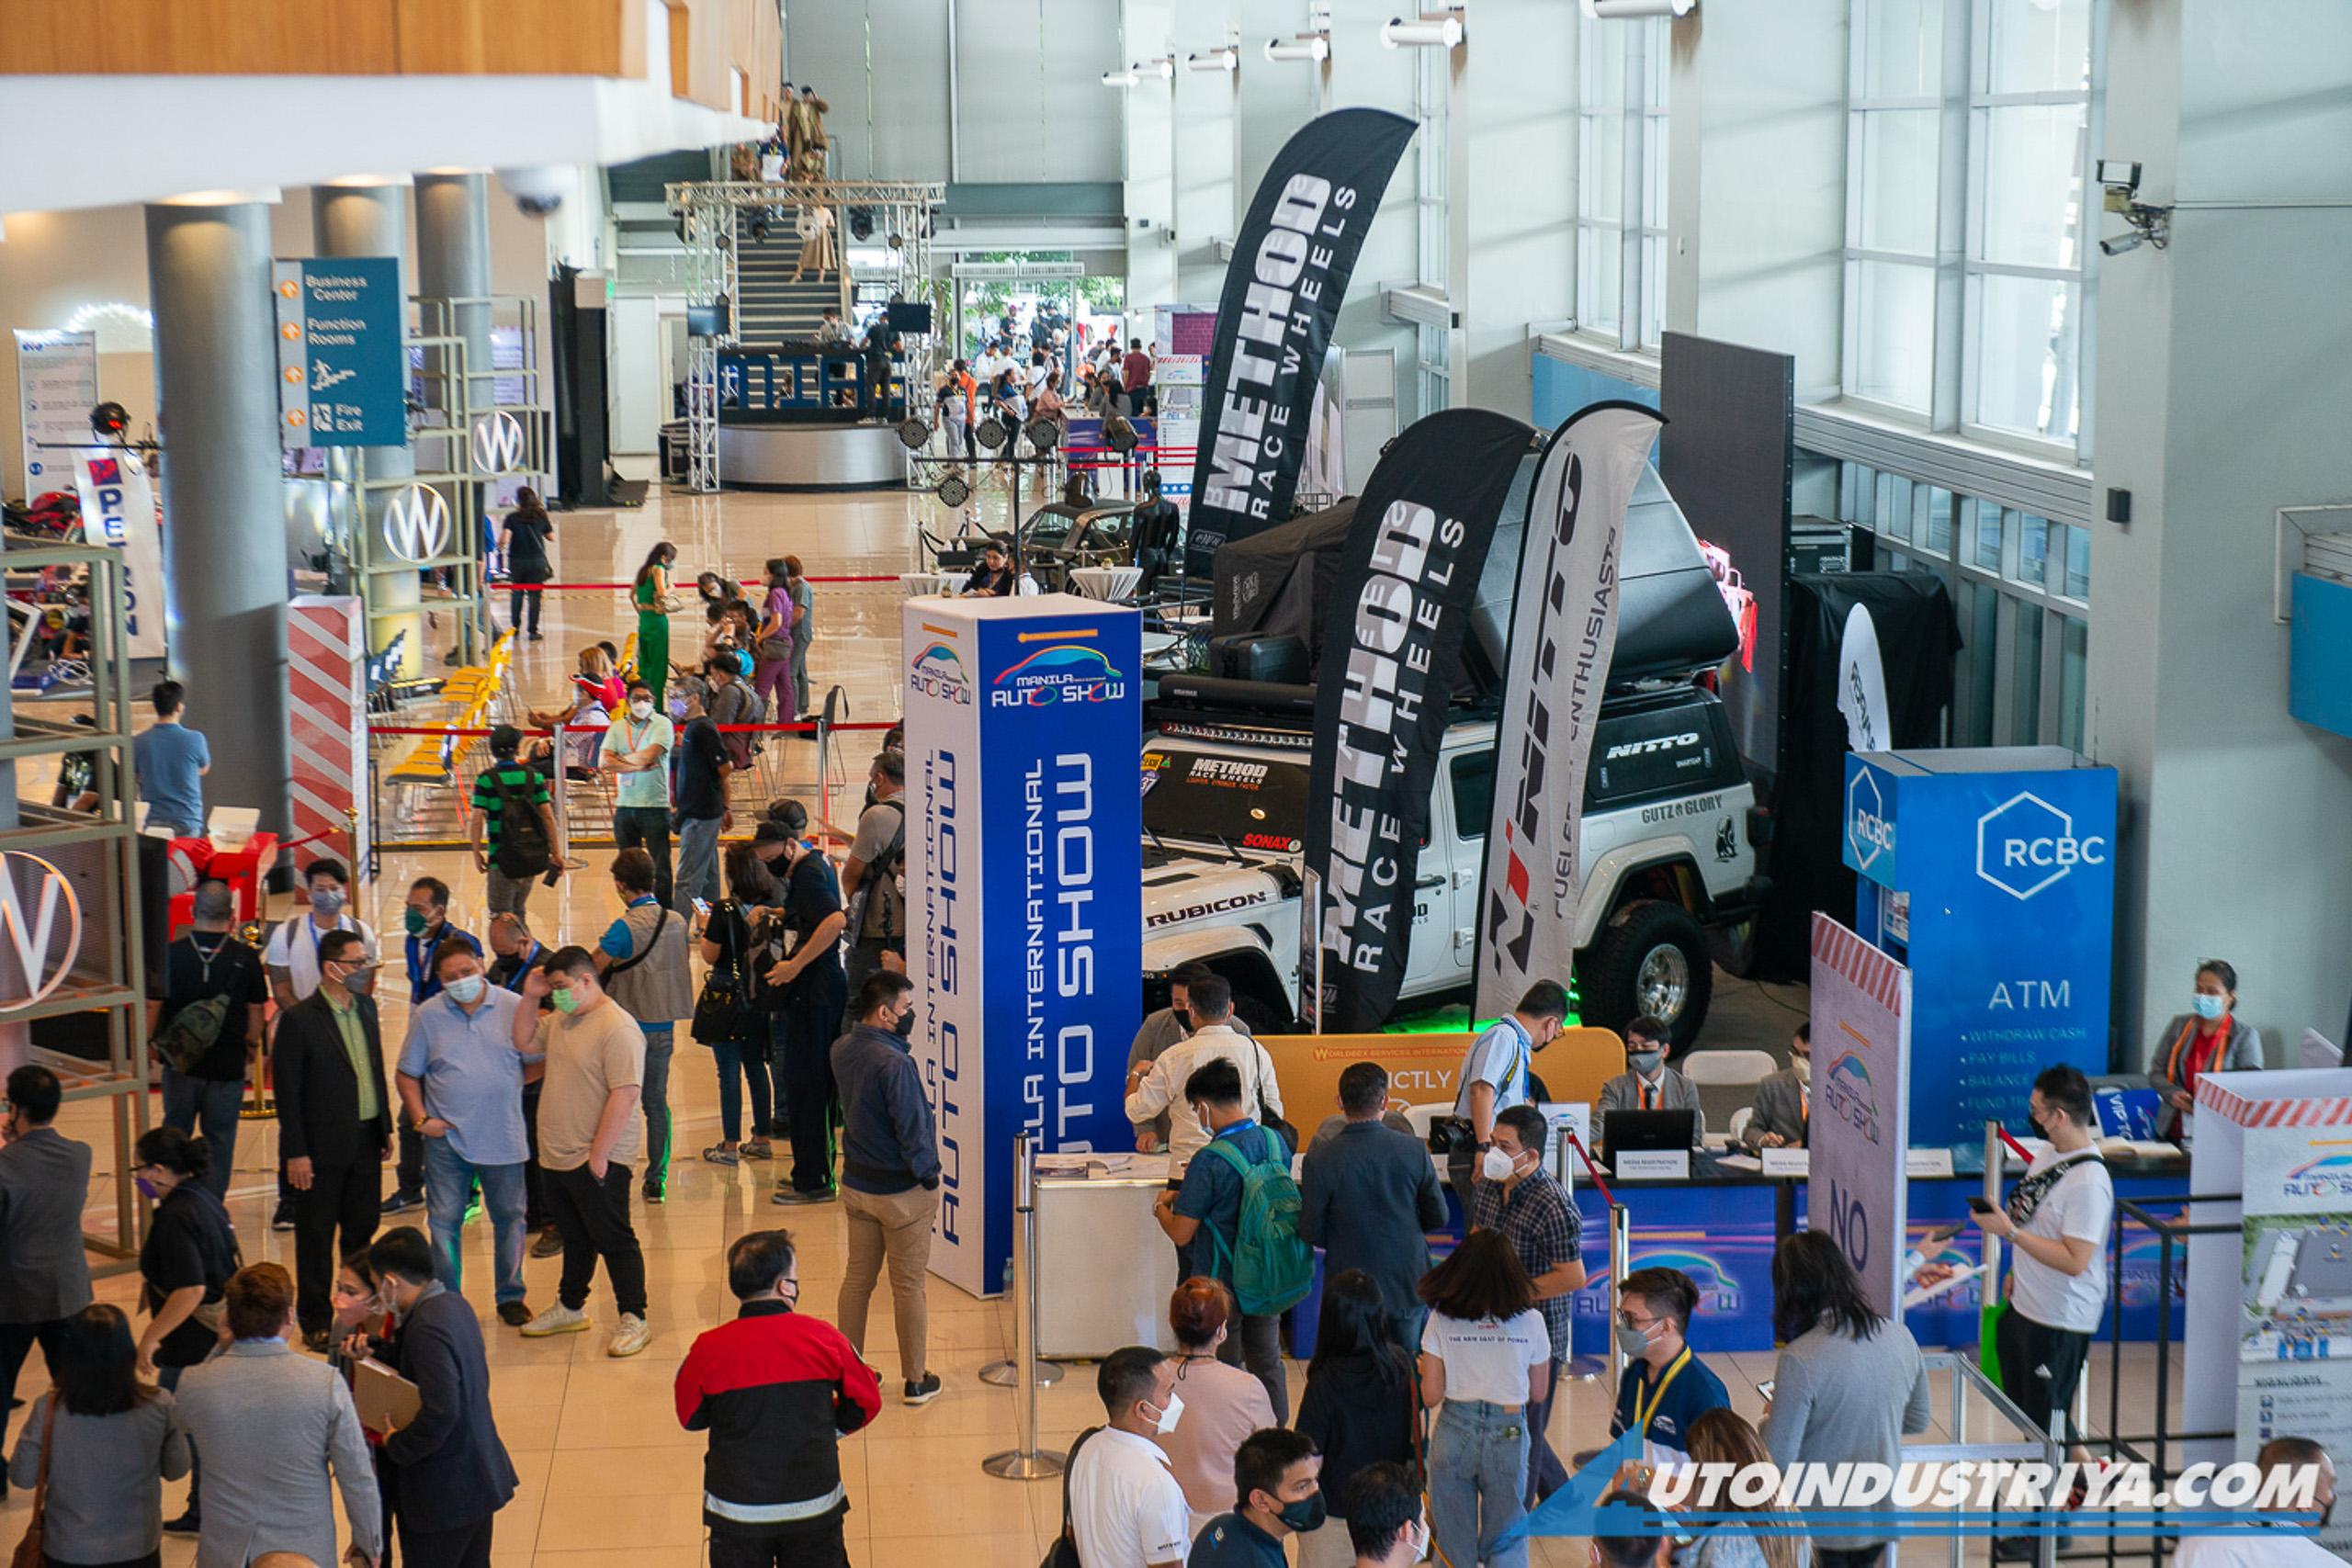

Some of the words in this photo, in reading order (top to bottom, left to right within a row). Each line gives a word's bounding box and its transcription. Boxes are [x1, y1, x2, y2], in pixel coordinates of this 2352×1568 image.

[305, 275, 368, 288] Business
[313, 288, 358, 301] Center
[308, 317, 367, 331] Function
[309, 333, 356, 345] Rooms
[1203, 173, 1331, 513] METHOD
[1250, 406, 1292, 520] RACE
[1281, 186, 1357, 376] WHEELS
[335, 403, 363, 416] Fire
[335, 418, 364, 432] Exit
[911, 673, 939, 697] AUTO
[942, 682, 970, 705] SHOW
[991, 685, 1057, 707] AUTO
[1062, 682, 1125, 703] SHOW
[1016, 673, 1073, 686] MANILA
[1324, 499, 1436, 966] METHOD
[1354, 818, 1401, 973] RACE
[1392, 518, 1464, 774] WHEELS
[1607, 732, 1700, 760] NITTO
[1188, 770, 1216, 779] RACE
[1220, 773, 1263, 785] WHEELS
[1192, 757, 1268, 778] METHOD
[1641, 807, 1675, 824] GUTZ
[1686, 794, 1723, 817] GLORY
[1242, 833, 1292, 851] SONAX
[1857, 807, 1893, 852] RCBC
[2004, 835, 2106, 867] RCBC
[939, 749, 958, 997] SHOW
[1057, 752, 1093, 998] SHOW
[926, 750, 936, 1044] INTERNATIONAL
[1025, 758, 1045, 1060] INTERNATIONAL
[1146, 891, 1267, 928] RUBICON
[1987, 979, 2071, 1010] ATM
[1968, 1028, 2044, 1043] WITHDRAW
[2049, 1027, 2087, 1041] CASH
[1968, 1053, 1993, 1065] PAY
[1998, 1051, 2037, 1064] BILLS
[1387, 1070, 1453, 1089] ICTLY
[1968, 1075, 2030, 1087] BALANCE
[1826, 1084, 1853, 1122] AUTO
[1853, 1106, 1880, 1146] SHOW
[940, 1024, 959, 1247] AUTO
[1829, 1178, 1870, 1273] NO
